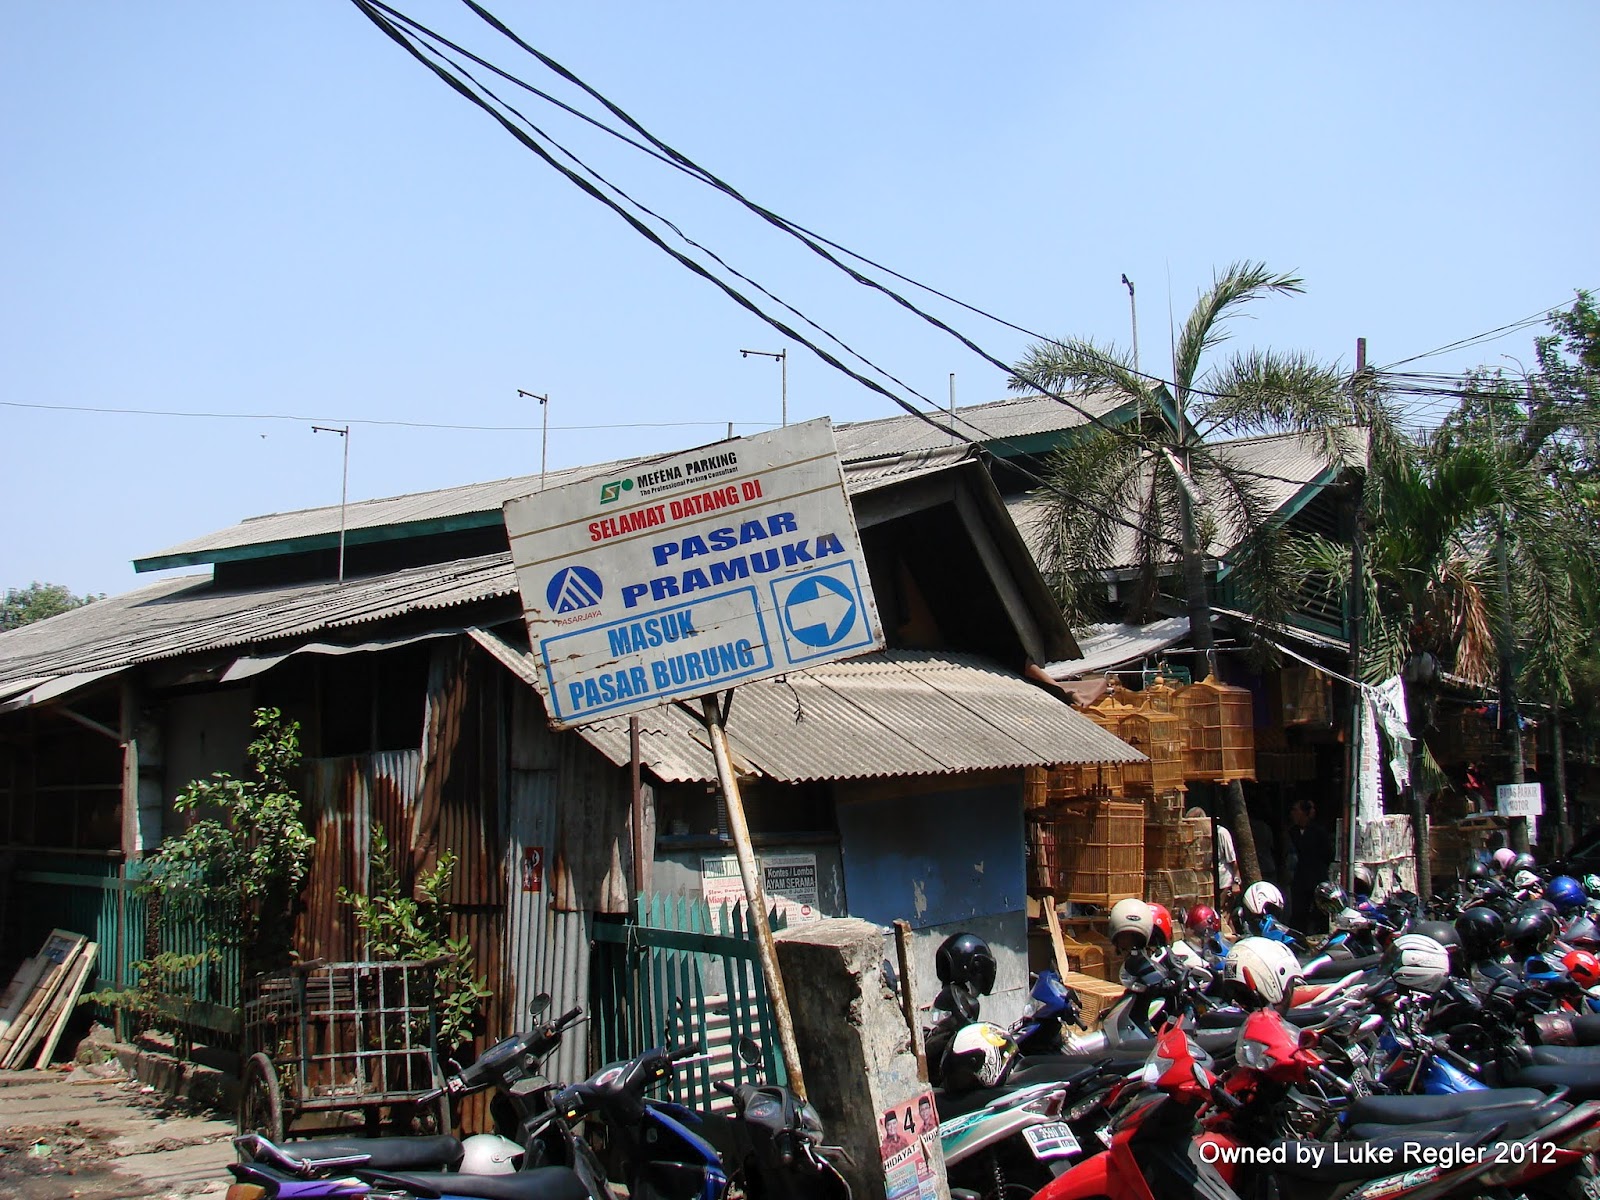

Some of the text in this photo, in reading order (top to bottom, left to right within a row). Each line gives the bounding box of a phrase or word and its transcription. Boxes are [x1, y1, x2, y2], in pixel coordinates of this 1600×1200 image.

[637, 452, 737, 488] MEFENA PARKING
[640, 466, 738, 496] The Professional Parking Consultant
[588, 479, 763, 542] SELAMAT DATANG DI
[652, 511, 798, 567] PASAR
[621, 532, 846, 608] PRAMUKA
[607, 609, 699, 657] MASUK
[569, 638, 755, 710] PASAR BURUNG
[766, 876, 815, 890] AYAM SERAMA
[767, 868, 789, 878] Kontes
[793, 866, 814, 876] Lomba
[903, 1106, 916, 1134] 4
[883, 1144, 917, 1170] HIDAYAT
